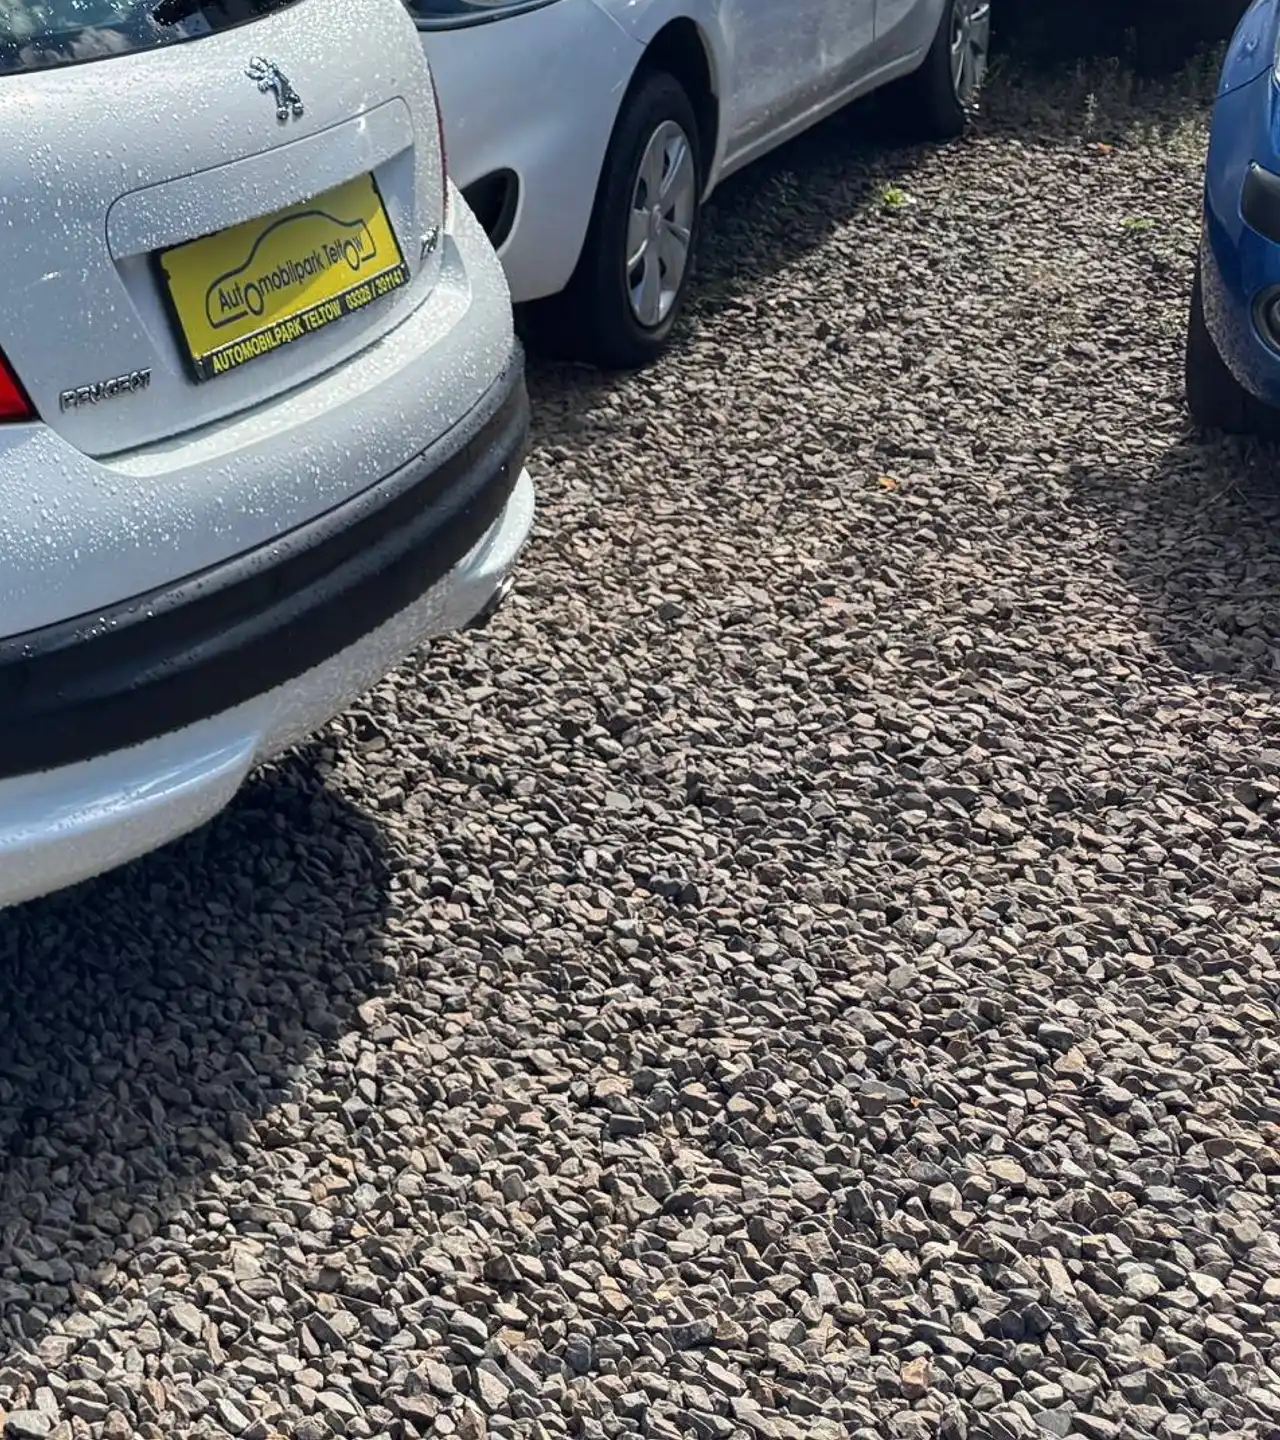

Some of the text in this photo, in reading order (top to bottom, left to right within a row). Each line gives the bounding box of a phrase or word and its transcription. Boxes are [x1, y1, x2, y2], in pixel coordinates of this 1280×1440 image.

[212, 319, 304, 374] AUTOMOBILPARK
[302, 299, 342, 332] TELTOW
[59, 366, 153, 414] PEUGEOT
